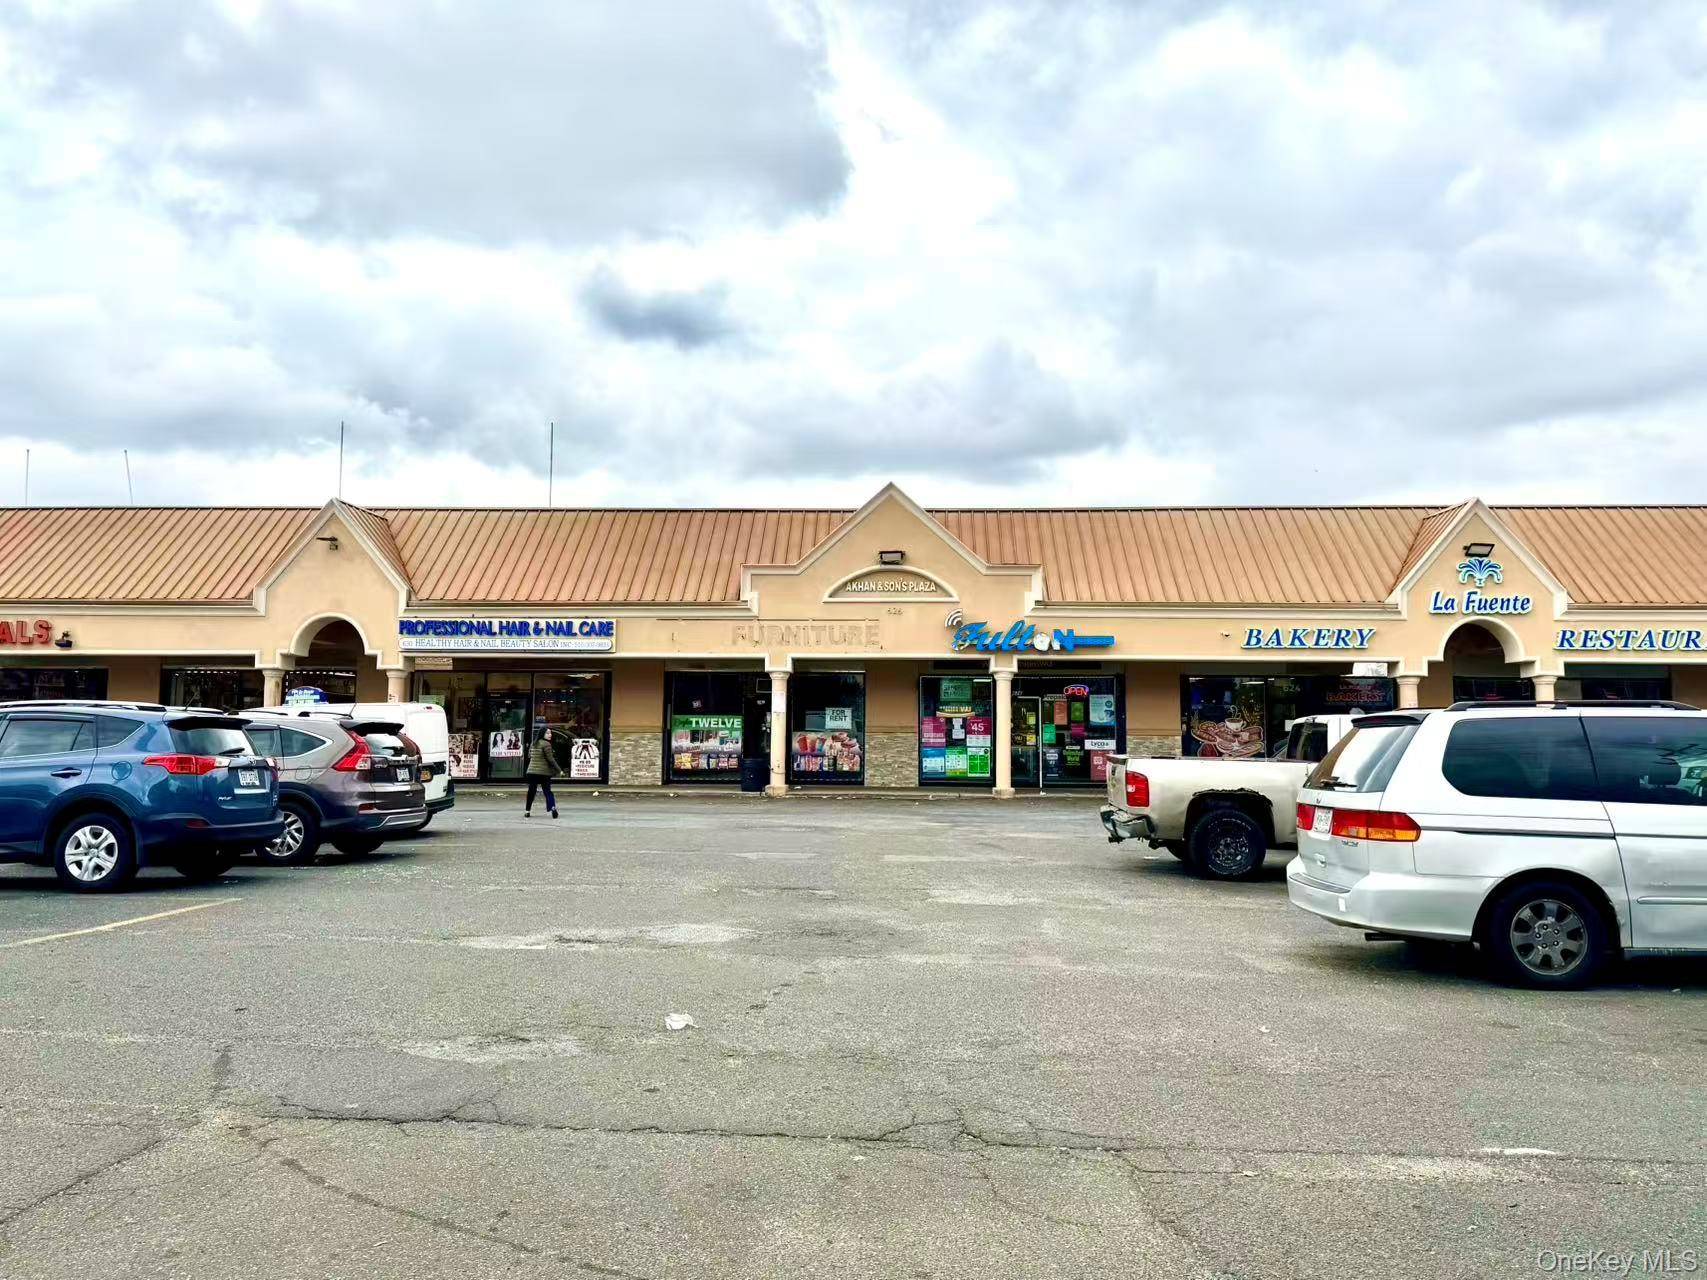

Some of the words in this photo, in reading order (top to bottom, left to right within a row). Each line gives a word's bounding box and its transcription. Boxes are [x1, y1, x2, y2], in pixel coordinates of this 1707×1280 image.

[877, 581, 883, 592] &
[909, 582, 937, 592] PLAZA
[1430, 590, 1457, 613] La
[1462, 589, 1533, 614] Fuente
[398, 620, 497, 636] PROFESSIONAL
[498, 620, 531, 636] HAIR
[533, 621, 544, 636] &
[545, 621, 577, 636] NAIL
[579, 621, 614, 637] CARE
[731, 625, 880, 646] FURNITURE
[415, 639, 452, 647] HEALTHY
[453, 639, 473, 647] HAIR
[473, 639, 480, 647] &
[480, 639, 499, 647] NAIL
[500, 639, 532, 647] BEAUTY
[533, 639, 559, 648] SALON
[1241, 628, 1375, 649] BAKERY
[1553, 629, 1707, 650] RESTAUR
[1063, 686, 1088, 697] OPEN
[690, 717, 742, 728] TWELVE
